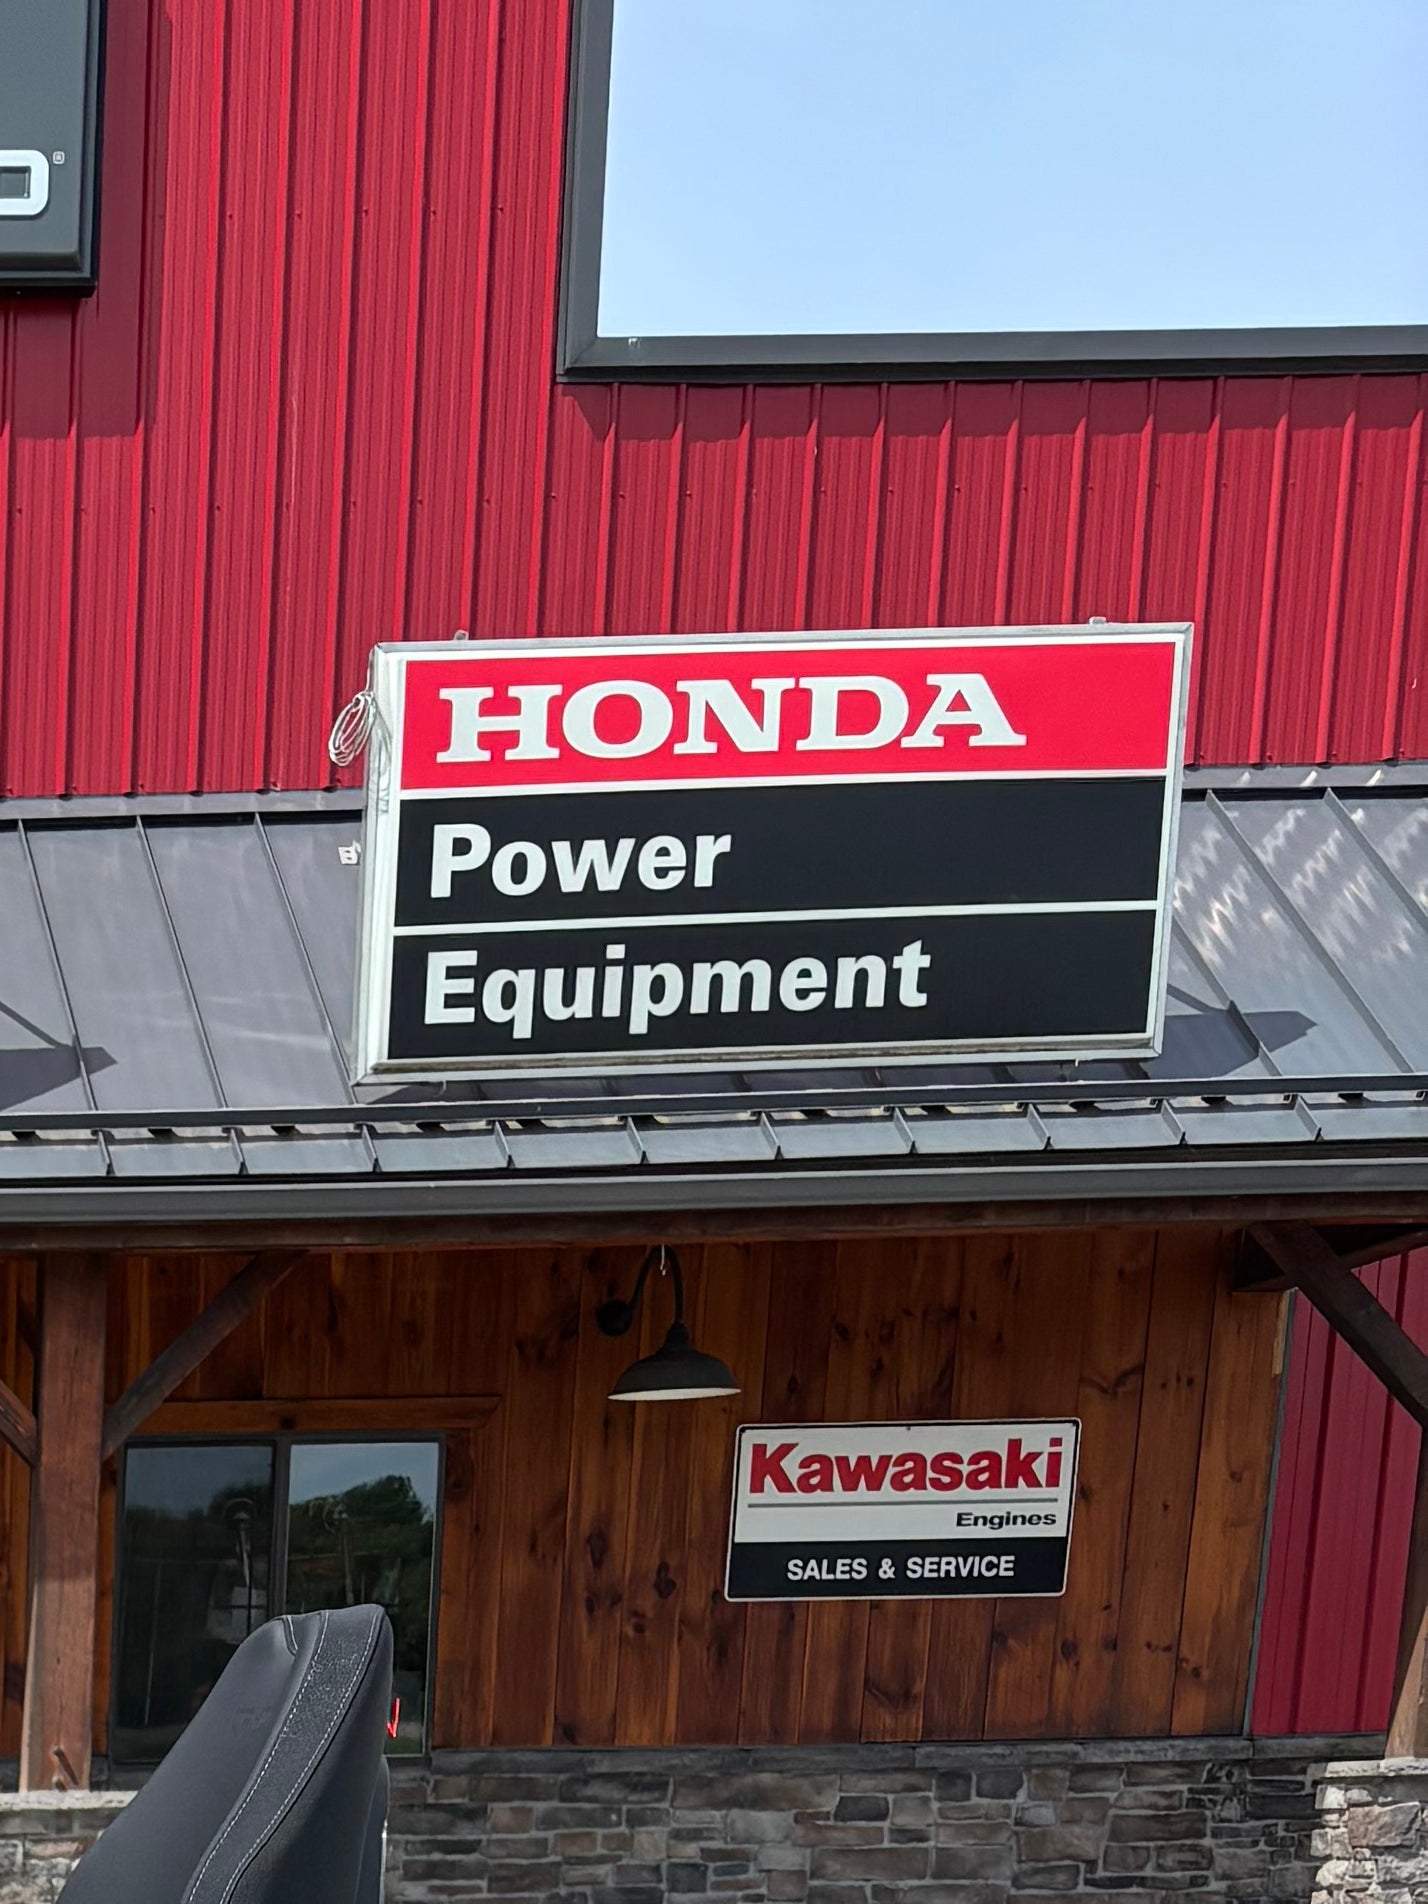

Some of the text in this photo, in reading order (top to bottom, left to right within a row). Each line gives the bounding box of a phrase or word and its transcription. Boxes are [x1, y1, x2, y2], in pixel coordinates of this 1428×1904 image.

[435, 673, 1028, 764] HONDA
[429, 823, 732, 900] Power
[424, 940, 932, 1040] Equipment
[748, 1437, 1063, 1494] Kawasaki
[955, 1511, 1057, 1531] Engines
[787, 1555, 1016, 1581] SALES & SERVICE
